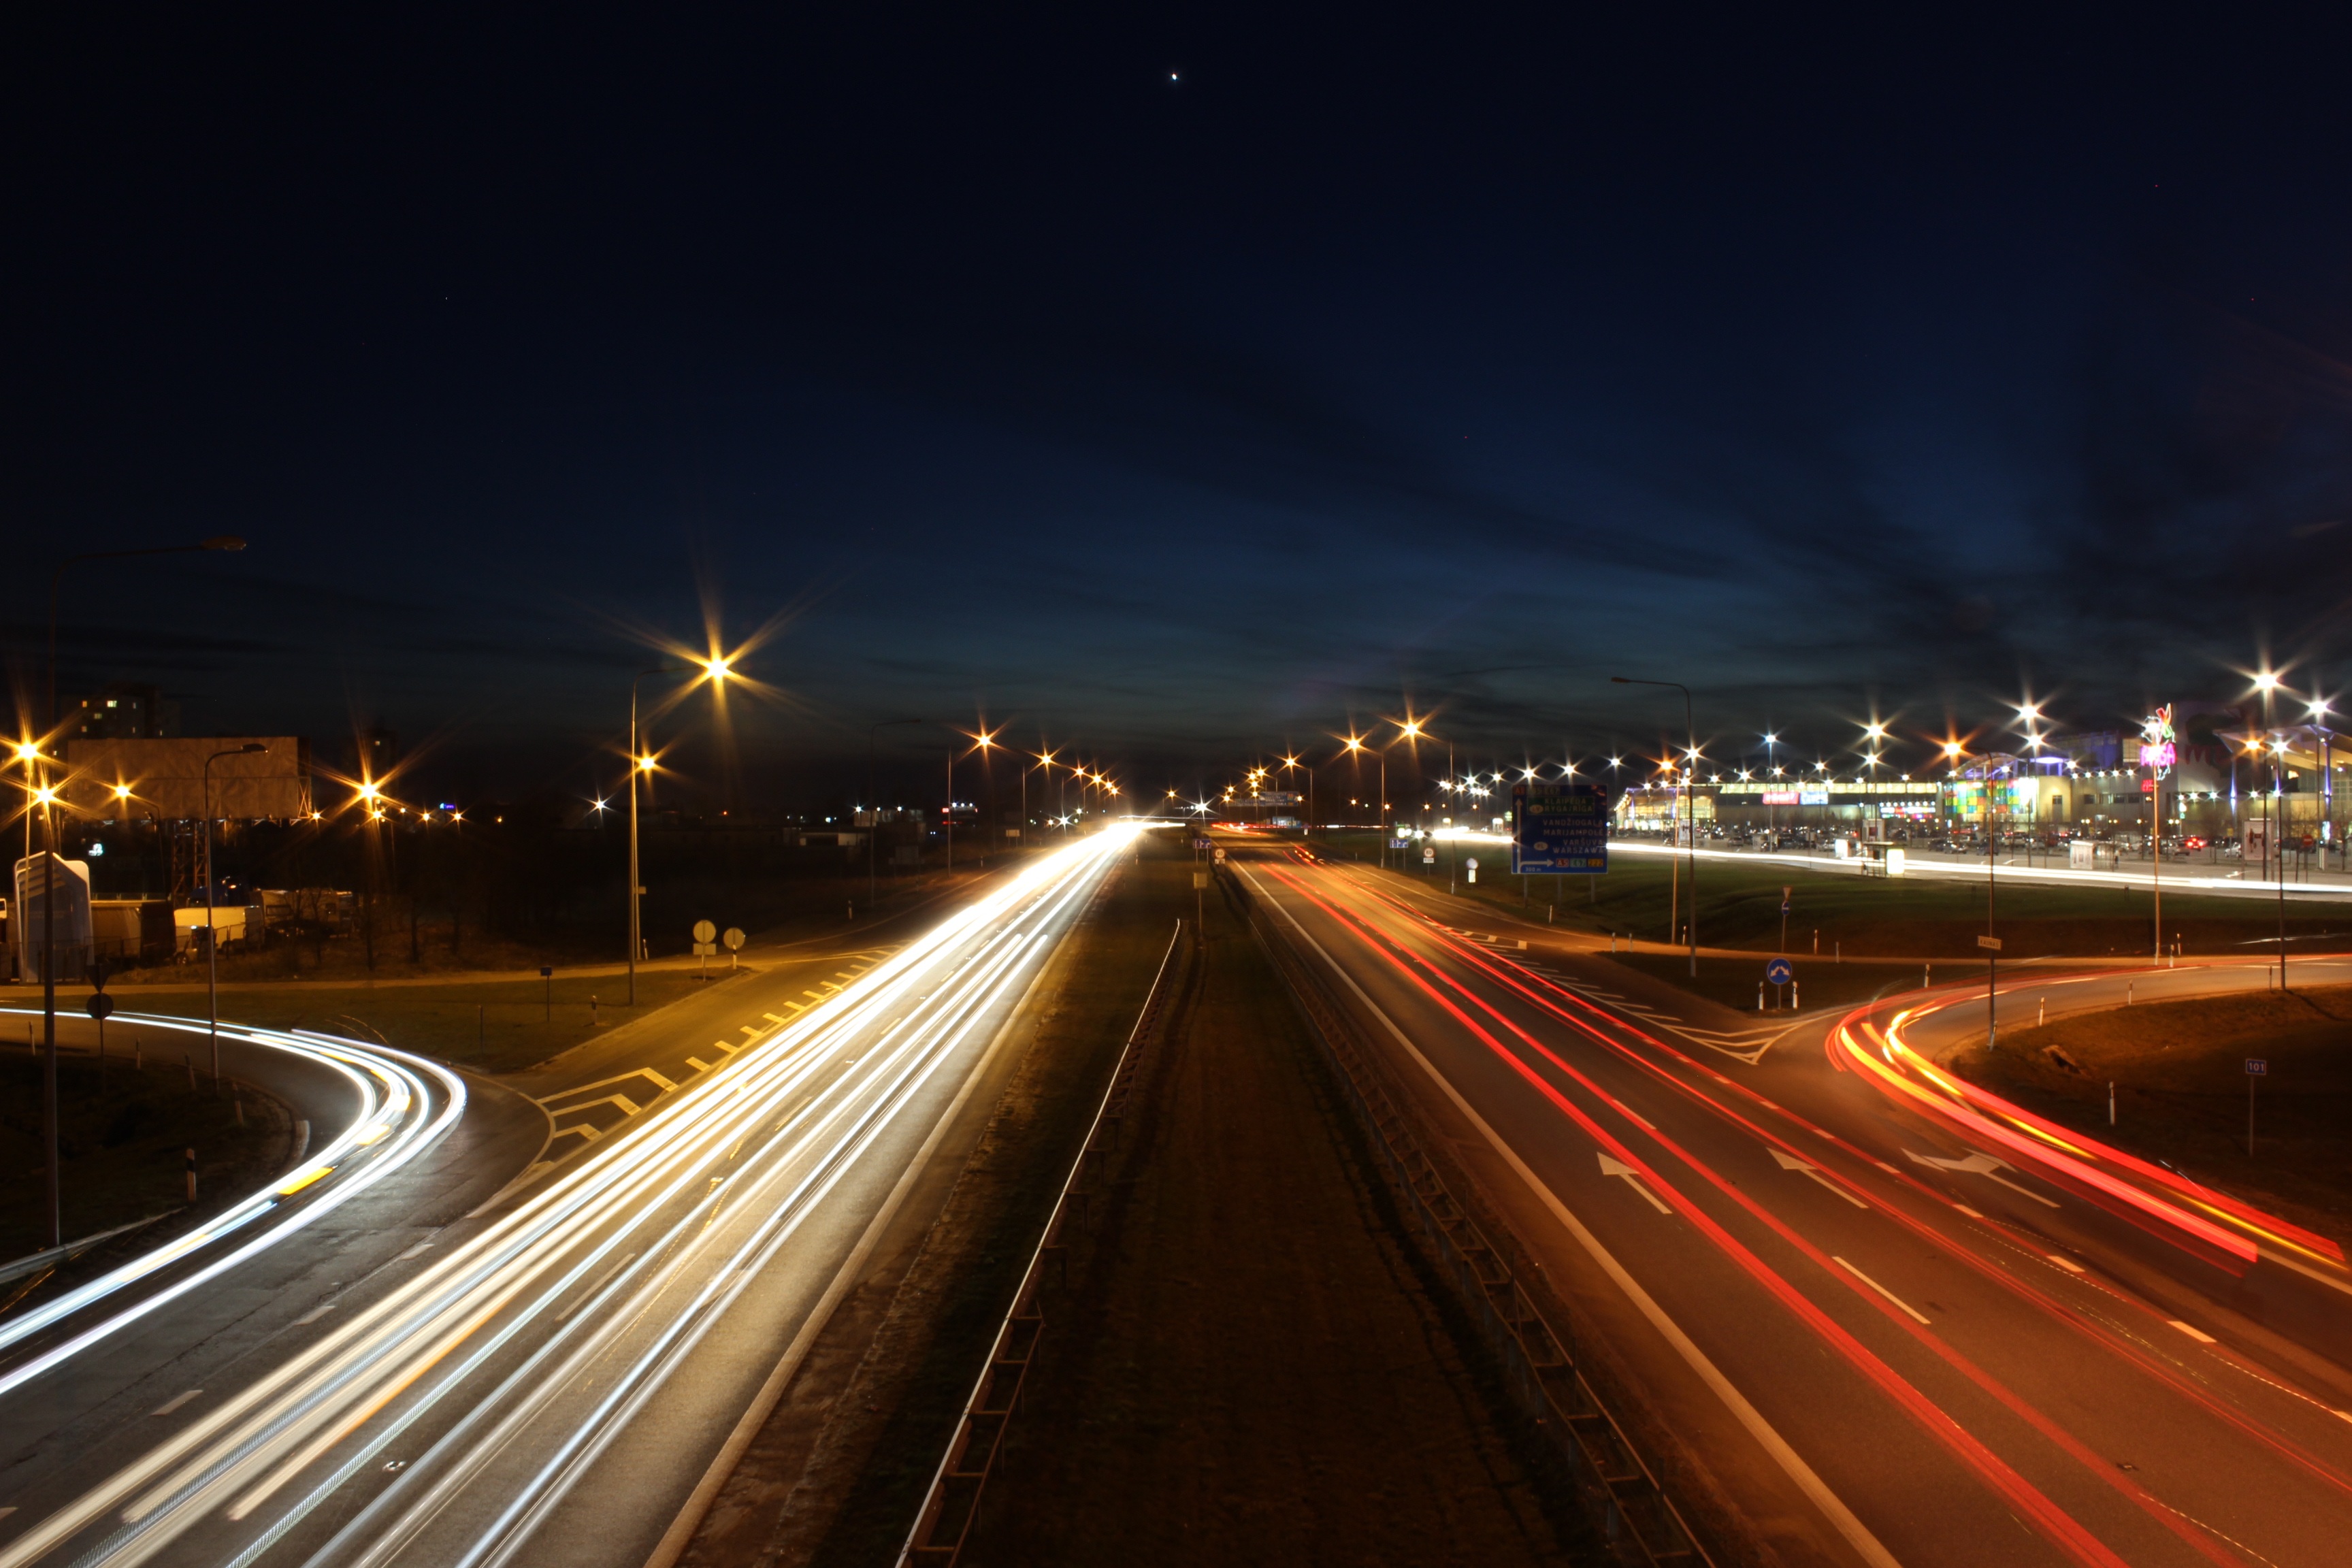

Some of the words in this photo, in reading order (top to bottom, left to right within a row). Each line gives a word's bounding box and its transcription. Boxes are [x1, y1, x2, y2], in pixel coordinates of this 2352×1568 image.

[1543, 817, 1603, 826] VANDŽIOGALA
[1544, 828, 1603, 836] MARIJAMPOLĖ
[1563, 837, 1603, 846] VARŠUVA
[2249, 1062, 2264, 1072] 101
